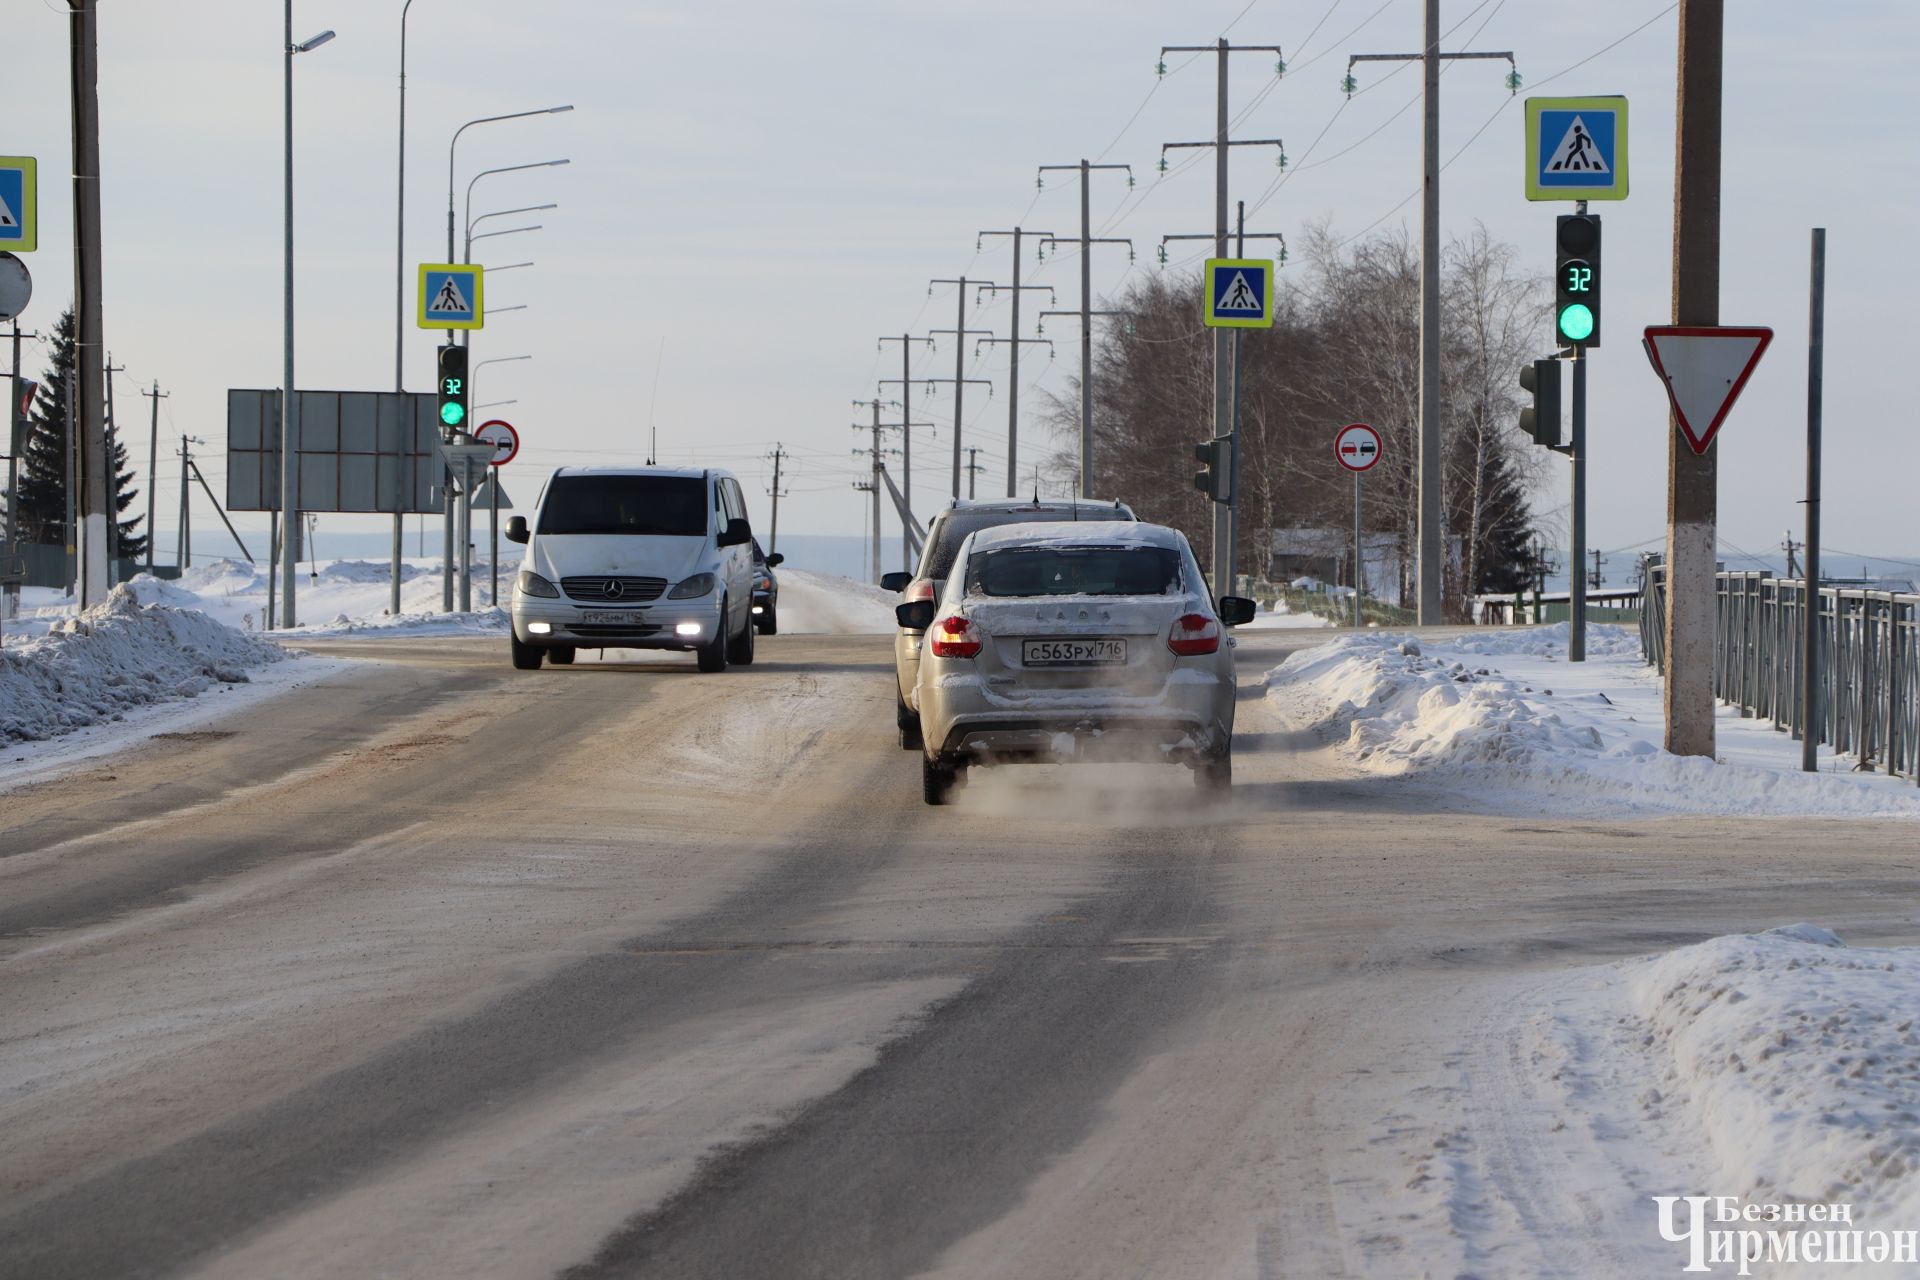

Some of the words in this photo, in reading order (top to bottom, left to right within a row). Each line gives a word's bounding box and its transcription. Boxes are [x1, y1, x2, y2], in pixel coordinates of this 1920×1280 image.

[1569, 268, 1591, 291] 32
[446, 379, 461, 394] 32
[1036, 610, 1111, 620] LADA
[1098, 642, 1122, 655] 716
